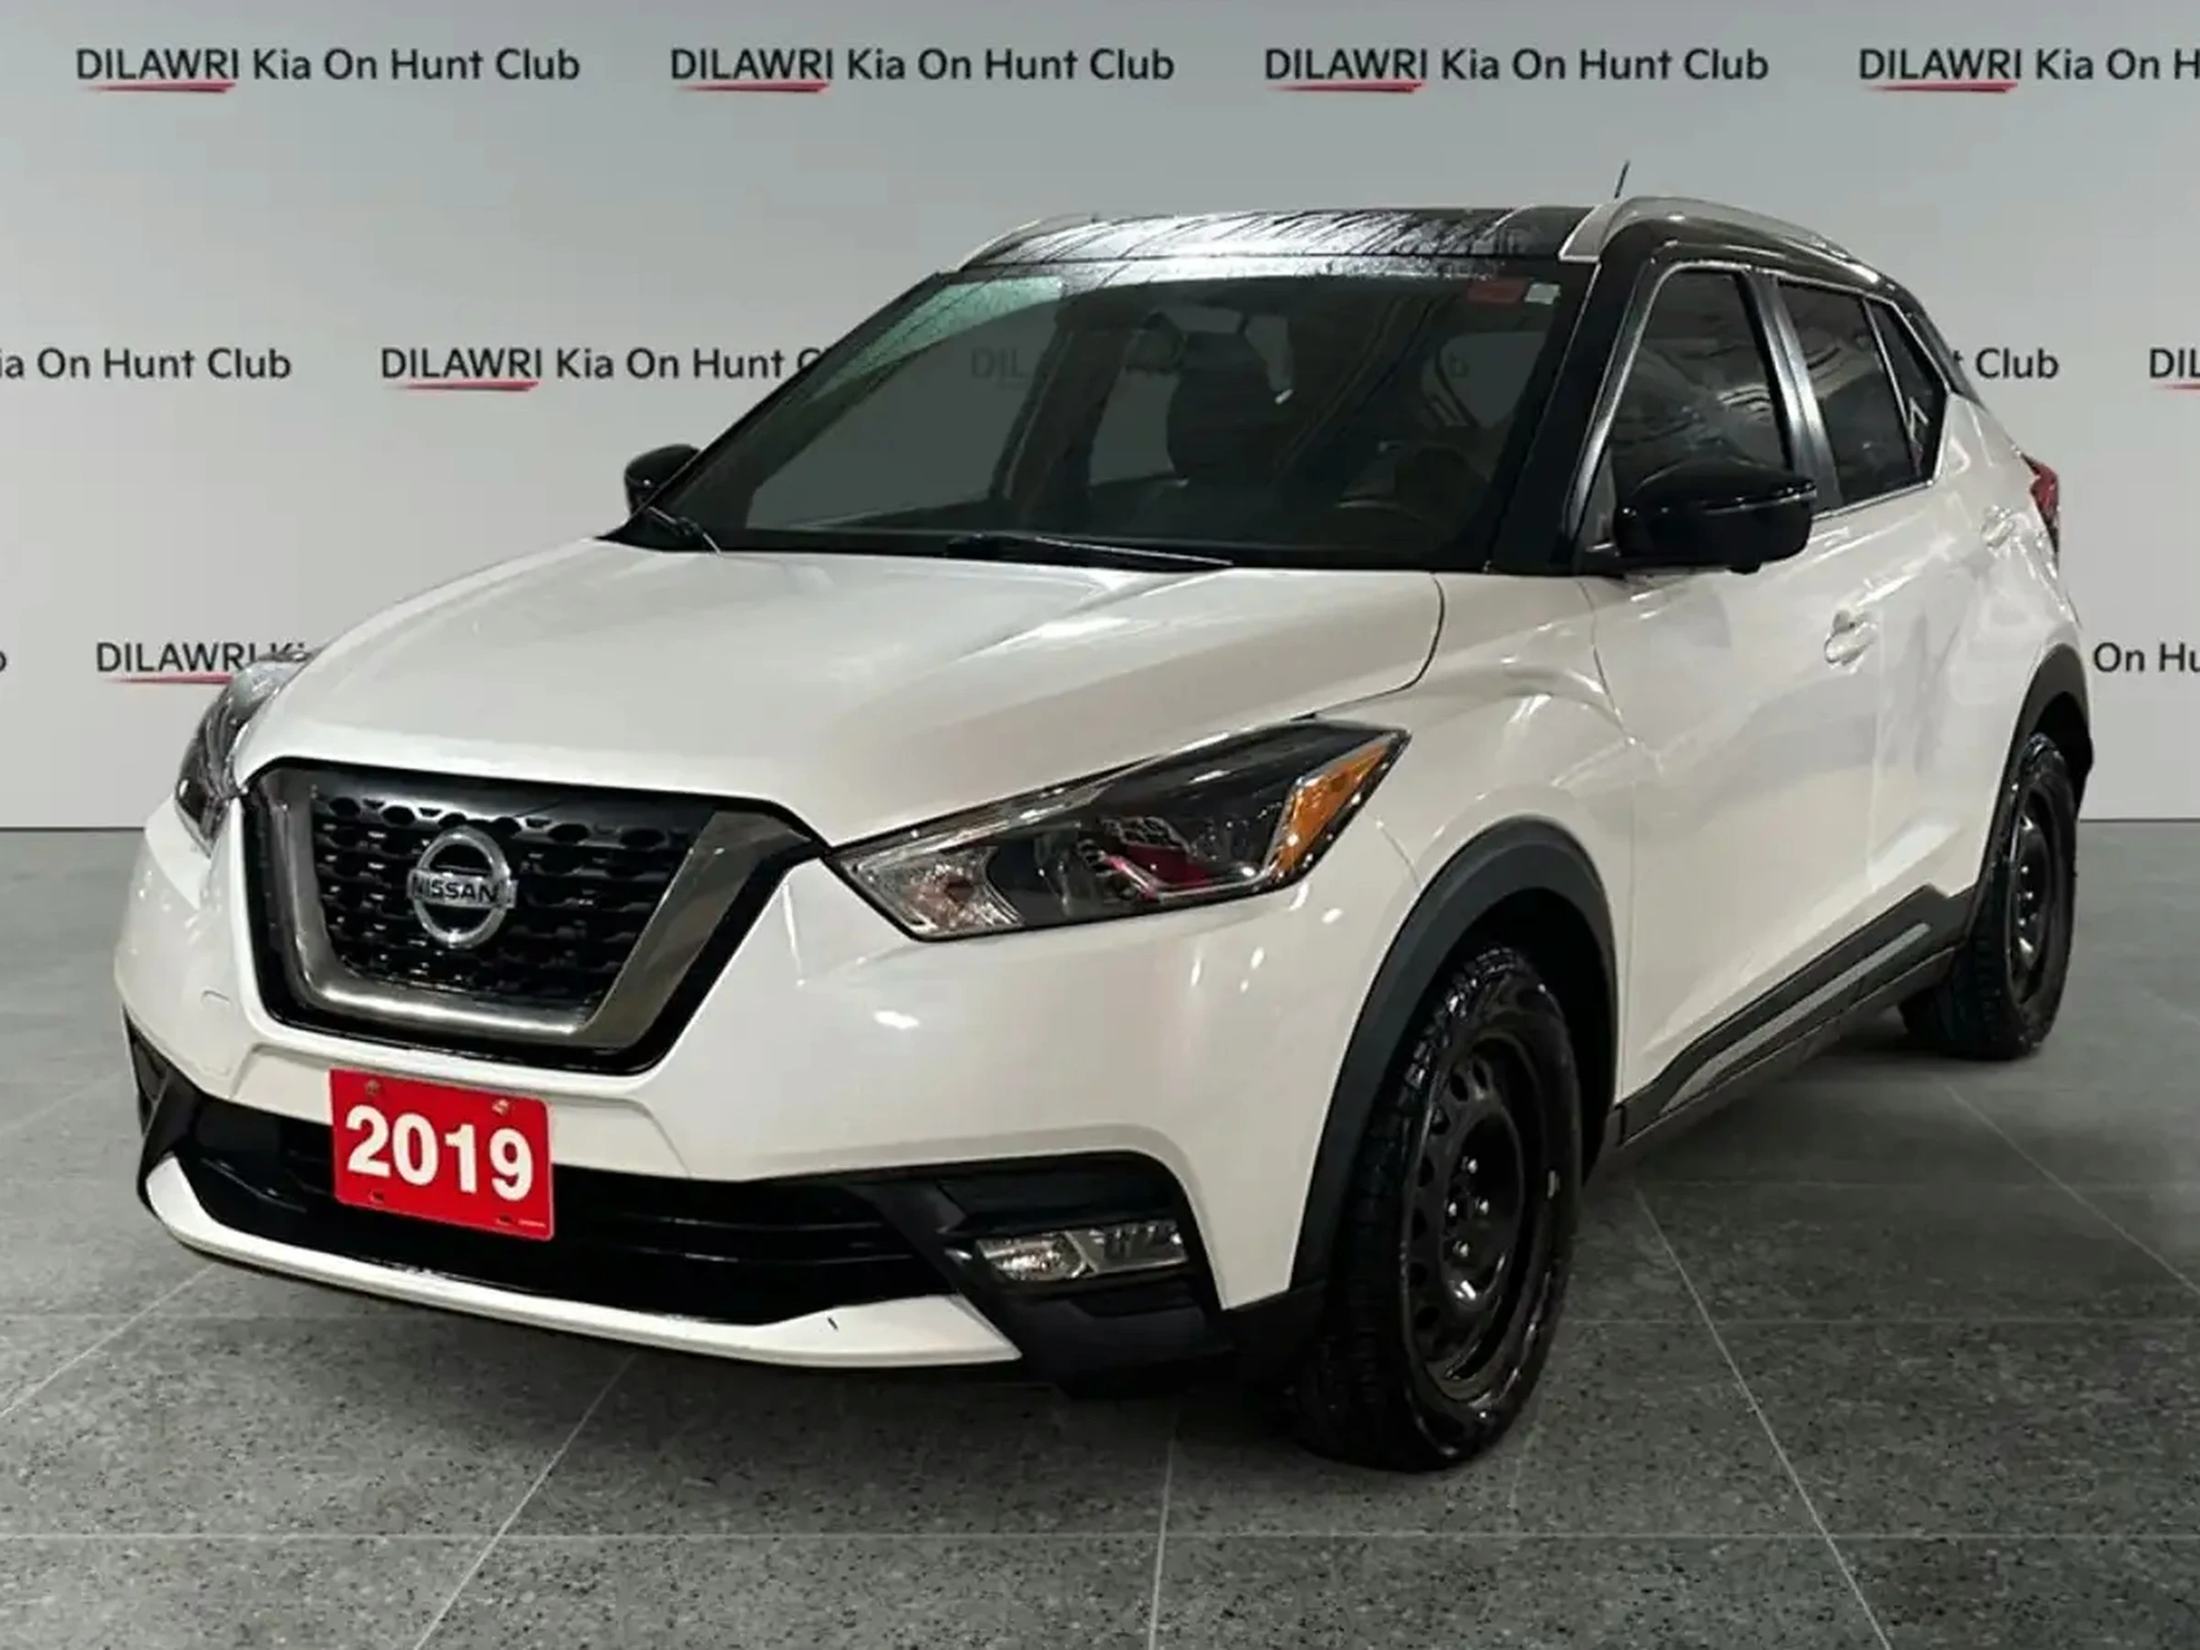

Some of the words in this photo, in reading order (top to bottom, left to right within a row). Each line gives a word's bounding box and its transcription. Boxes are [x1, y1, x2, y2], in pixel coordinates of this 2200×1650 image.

[76, 48, 239, 80] DILAWRI
[253, 48, 311, 80] Kia
[323, 48, 378, 80] On
[391, 48, 484, 80] Hunt
[495, 47, 581, 80] Club
[670, 48, 834, 80] DILAWRI
[847, 48, 906, 80] Kia
[917, 48, 972, 80] On
[985, 48, 1079, 80] Hunt
[1089, 47, 1175, 80] Club
[1265, 48, 1428, 80] DILAWRI
[1441, 48, 1500, 80] Kia
[1511, 48, 1566, 80] On
[1579, 48, 1673, 80] Hunt
[1683, 47, 1769, 80] Club
[1859, 48, 2022, 80] DILAWRI
[2035, 48, 2094, 80] Kia
[2106, 48, 2160, 80] On
[37, 347, 90, 379] On
[104, 348, 195, 379] Hunt
[207, 347, 291, 379] Club
[381, 347, 542, 379] DILAWRI
[556, 348, 614, 379] Kia
[626, 347, 680, 379] On
[693, 348, 785, 379] Hunt
[1975, 347, 2060, 379] Club
[96, 642, 256, 672] DILAWRI
[2093, 642, 2145, 673] On
[411, 876, 500, 903] NISSAN
[345, 1104, 533, 1201] 2019
